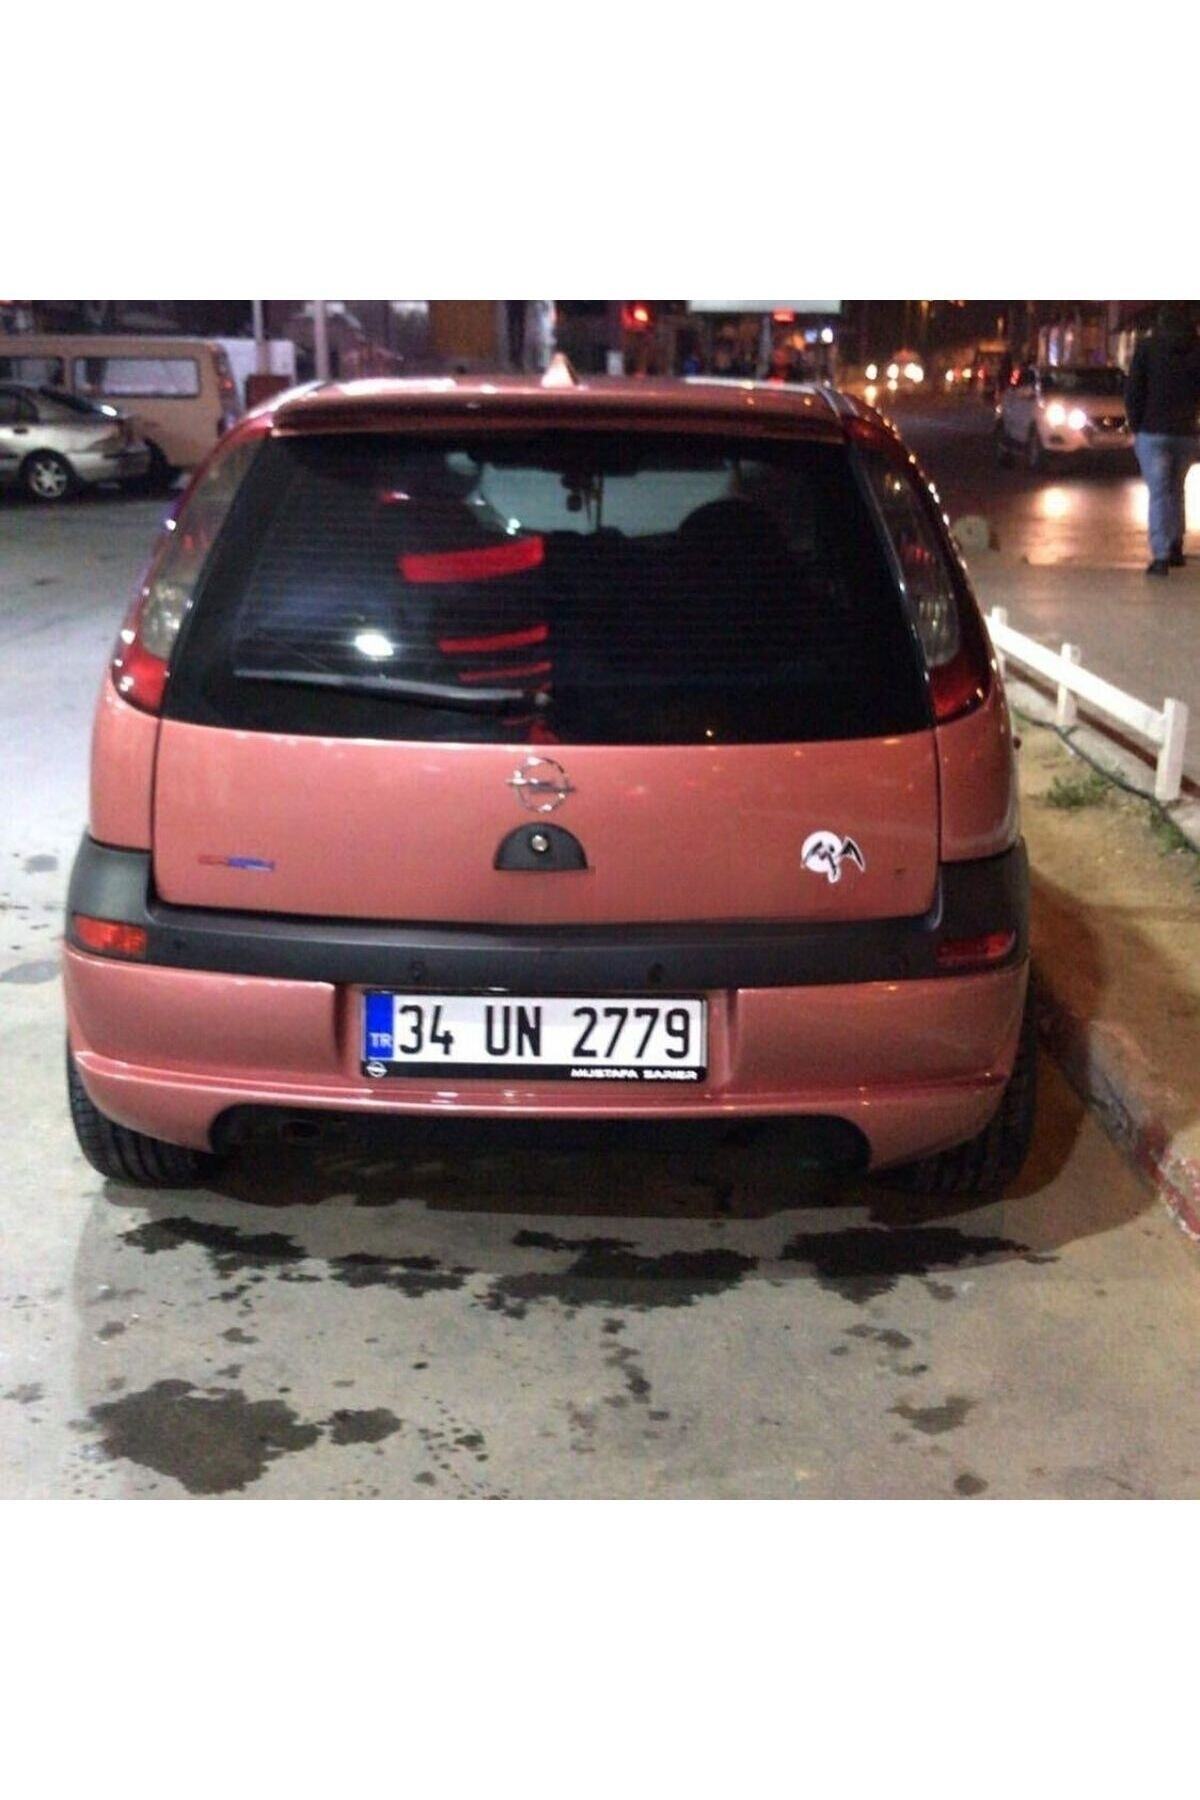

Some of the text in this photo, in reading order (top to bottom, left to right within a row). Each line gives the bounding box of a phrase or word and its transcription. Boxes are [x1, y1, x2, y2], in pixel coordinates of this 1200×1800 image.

[399, 1004, 690, 1059] 34 UN 2779
[370, 1033, 392, 1048] TR
[570, 1068, 639, 1079] MUSTAFA
